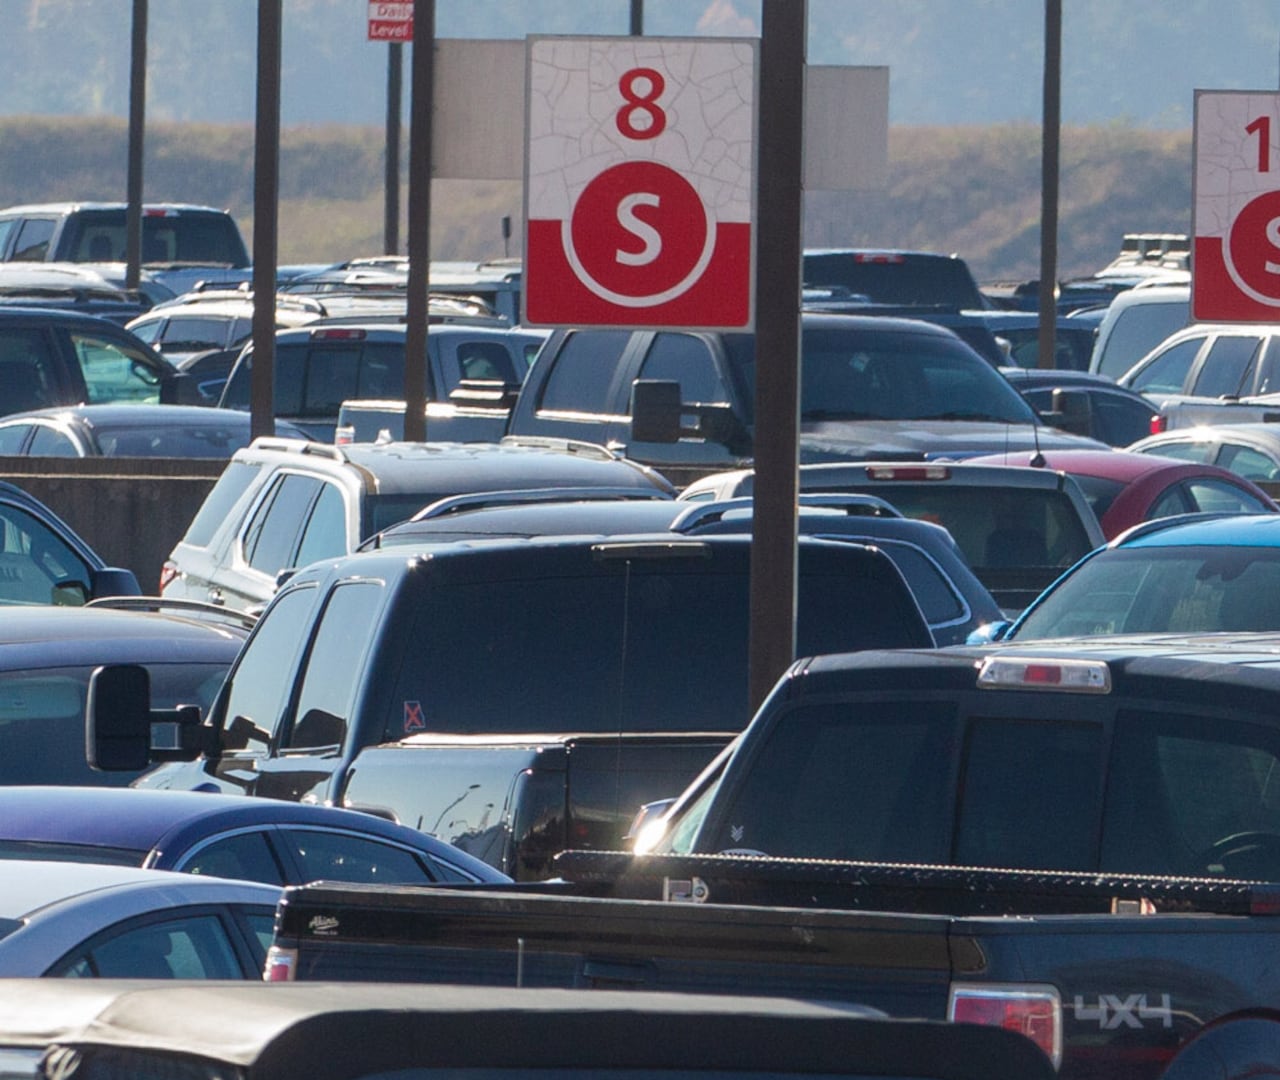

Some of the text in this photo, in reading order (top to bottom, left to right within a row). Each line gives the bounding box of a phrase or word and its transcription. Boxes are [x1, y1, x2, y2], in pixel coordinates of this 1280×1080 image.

[371, 22, 409, 37] Level
[616, 67, 666, 140] 8
[616, 192, 662, 266] S
